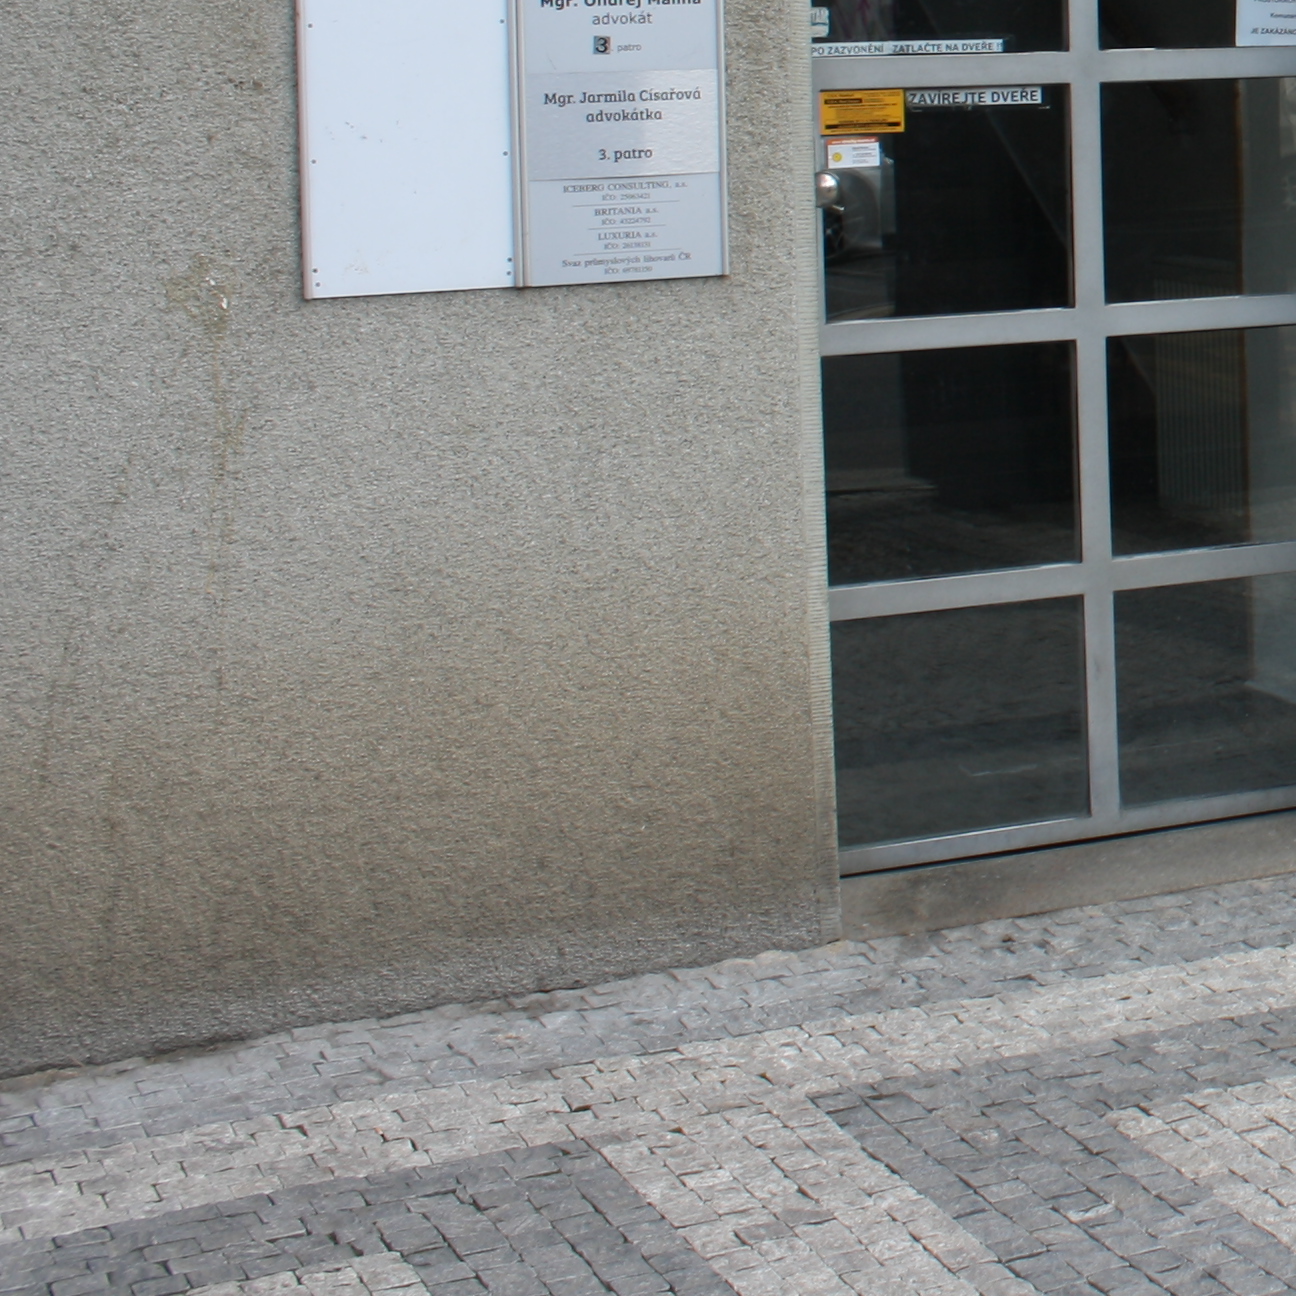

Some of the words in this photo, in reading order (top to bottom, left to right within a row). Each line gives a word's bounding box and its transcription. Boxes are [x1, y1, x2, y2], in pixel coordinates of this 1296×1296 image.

[592, 11, 652, 25] advokát
[617, 44, 642, 52] patro
[892, 42, 943, 53] ZATLAČTE
[945, 42, 959, 52] NA
[961, 40, 993, 52] DVEŘE
[544, 93, 576, 107] Mgr.
[580, 90, 636, 104] Jarmila
[639, 86, 701, 102] Císařová
[908, 90, 986, 104] ZAVÍREJTE
[991, 88, 1039, 103] DVEŘE
[586, 107, 663, 123] advokátka
[598, 149, 610, 160] 3.
[614, 149, 652, 162] patro
